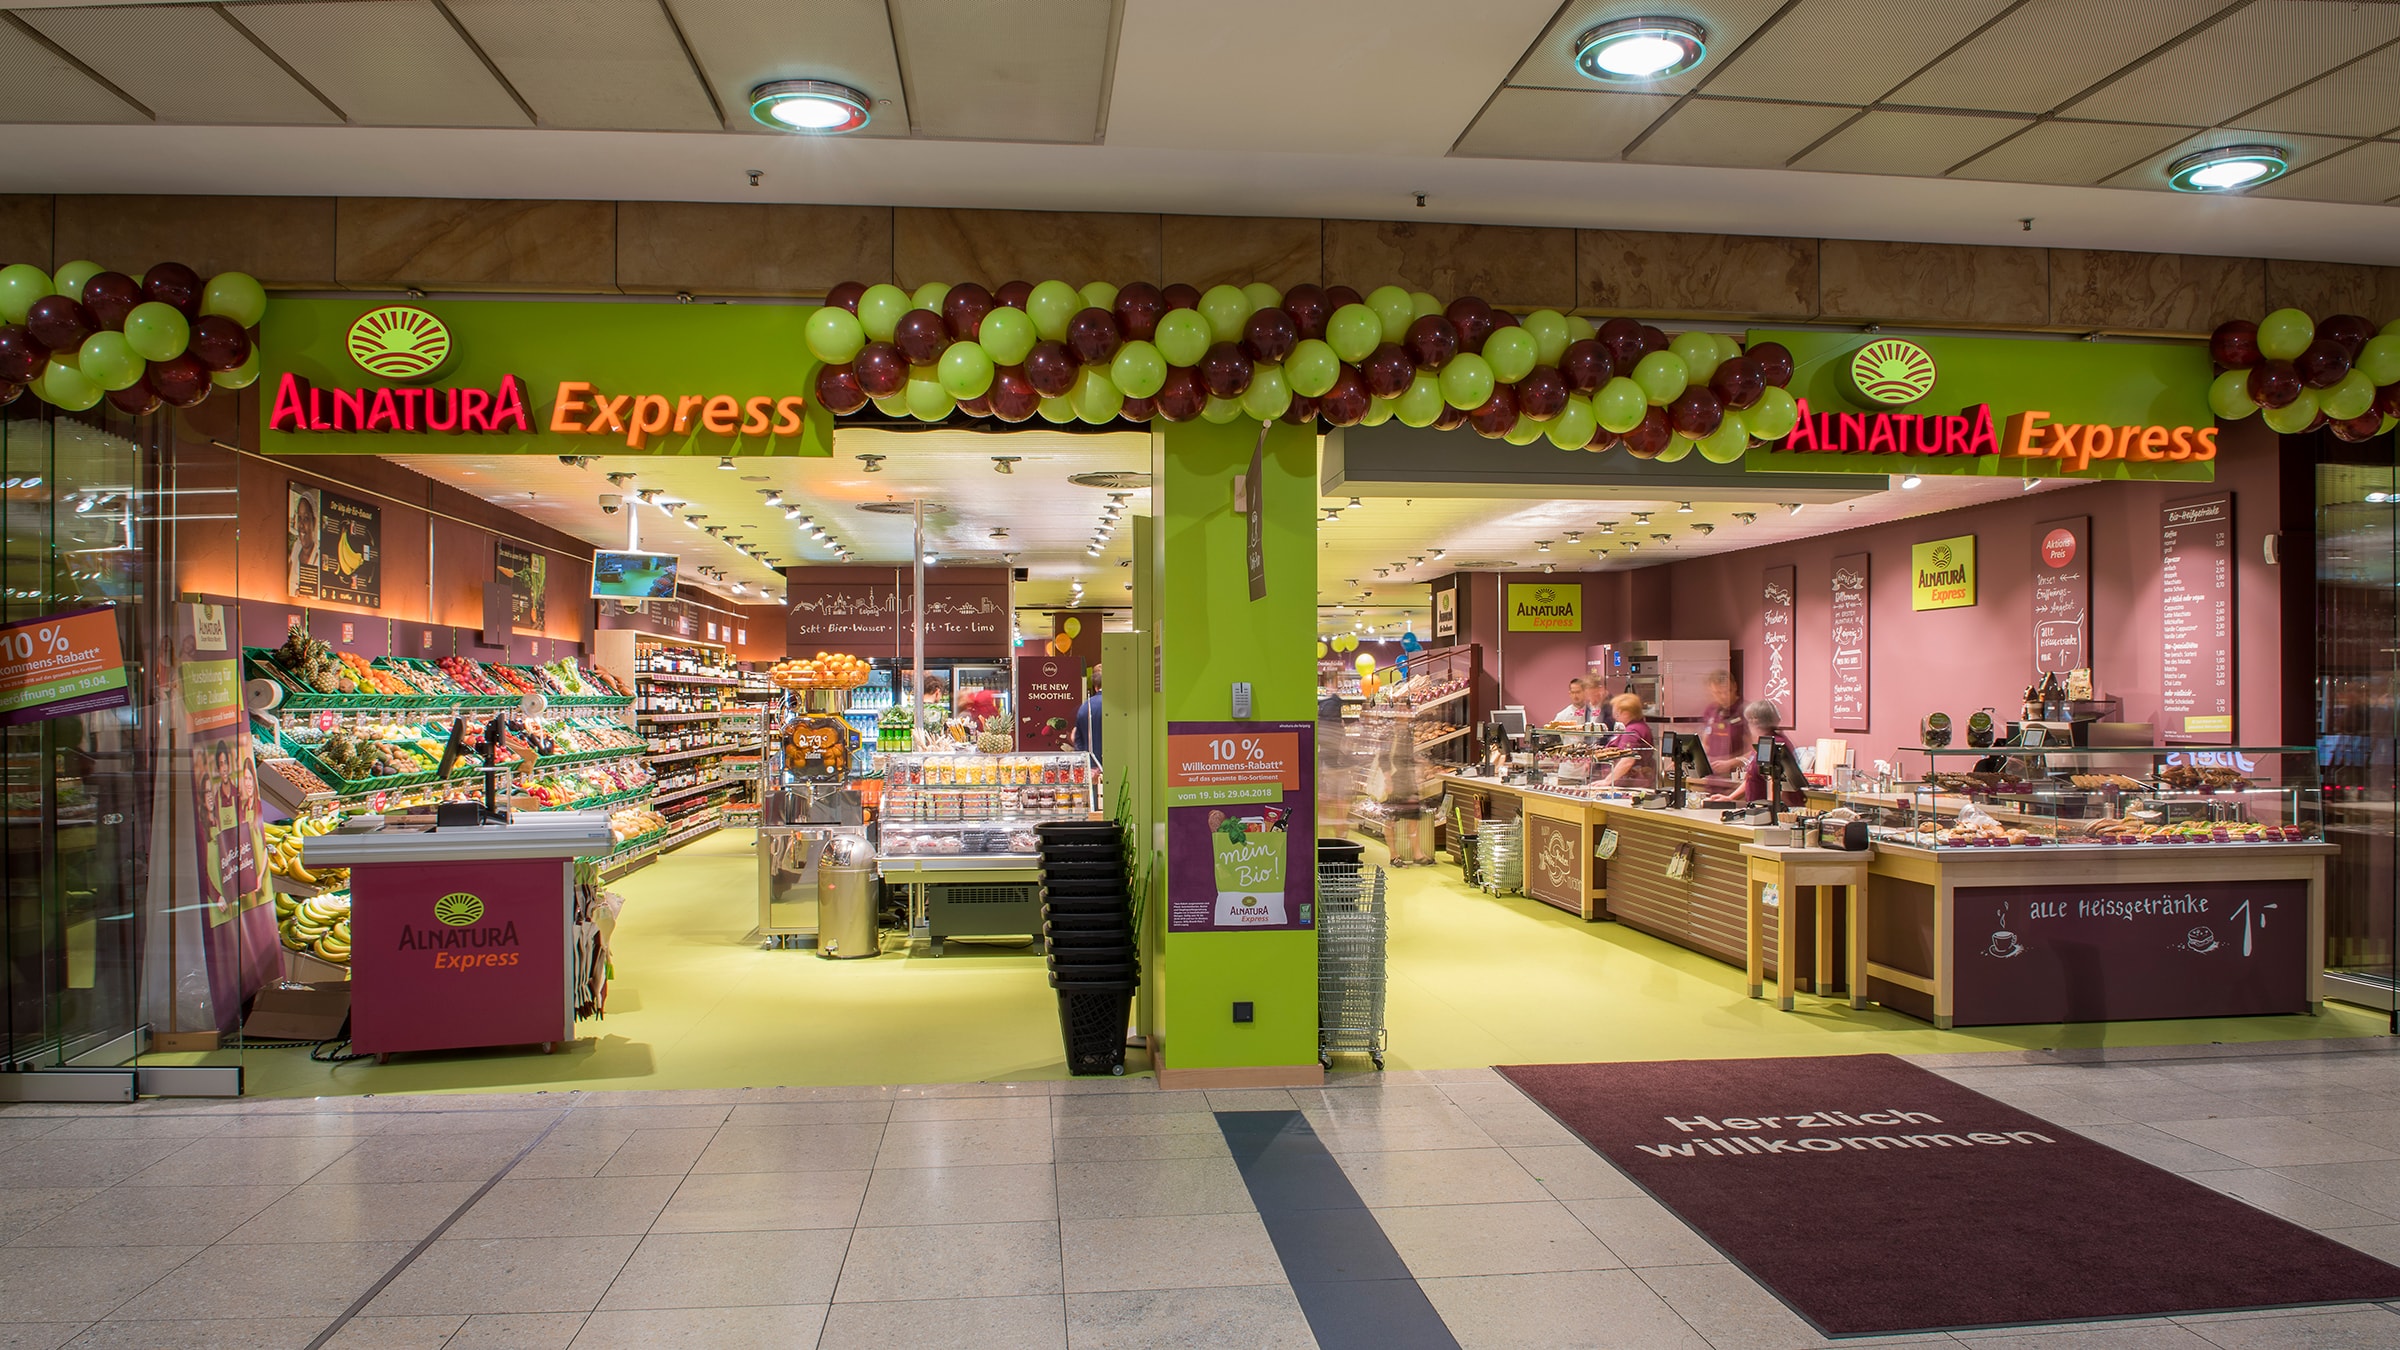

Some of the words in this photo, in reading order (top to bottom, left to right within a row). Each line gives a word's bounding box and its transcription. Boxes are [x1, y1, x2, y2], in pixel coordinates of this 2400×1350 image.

[269, 371, 530, 433] ALNATURA
[549, 380, 806, 450] Express
[1783, 397, 2001, 456] ALNATURA
[2016, 410, 2219, 472] Express
[2045, 538, 2071, 550] Aktions
[2050, 548, 2066, 560] Preis
[1918, 563, 1967, 589] ALNATURA
[1931, 588, 1966, 604] Express
[1516, 602, 1574, 617] ALNATURA
[828, 623, 849, 633] Bier
[852, 623, 886, 633] Wasser
[910, 622, 936, 635] Sft
[944, 622, 962, 633] Tee
[971, 623, 995, 632] Limo
[1533, 617, 1574, 629] Express
[0, 631, 34, 661] 10
[39, 624, 70, 655] %
[59, 683, 76, 694] am
[79, 675, 111, 689] 19.04.
[1031, 683, 1048, 691] THE
[1049, 683, 1069, 691] NEW
[1028, 692, 1074, 700] SMOOTHIE.
[1208, 739, 1236, 761] 10
[1241, 738, 1265, 761] %
[1211, 775, 1237, 783] gesamte
[1178, 793, 1197, 801] vom
[1199, 791, 1212, 800] 19.
[1213, 790, 1226, 799] bis
[1227, 788, 1272, 799] 29.04.2018
[1219, 841, 1277, 865] mein
[1234, 856, 1280, 888] Bio!
[1230, 905, 1269, 916] ALNATURA
[1241, 915, 1269, 923] Express
[398, 920, 520, 951] ALNATURA
[435, 951, 520, 973] Express
[1663, 1108, 1945, 1132] Herzlich
[1634, 1128, 2058, 1159] willkommen
